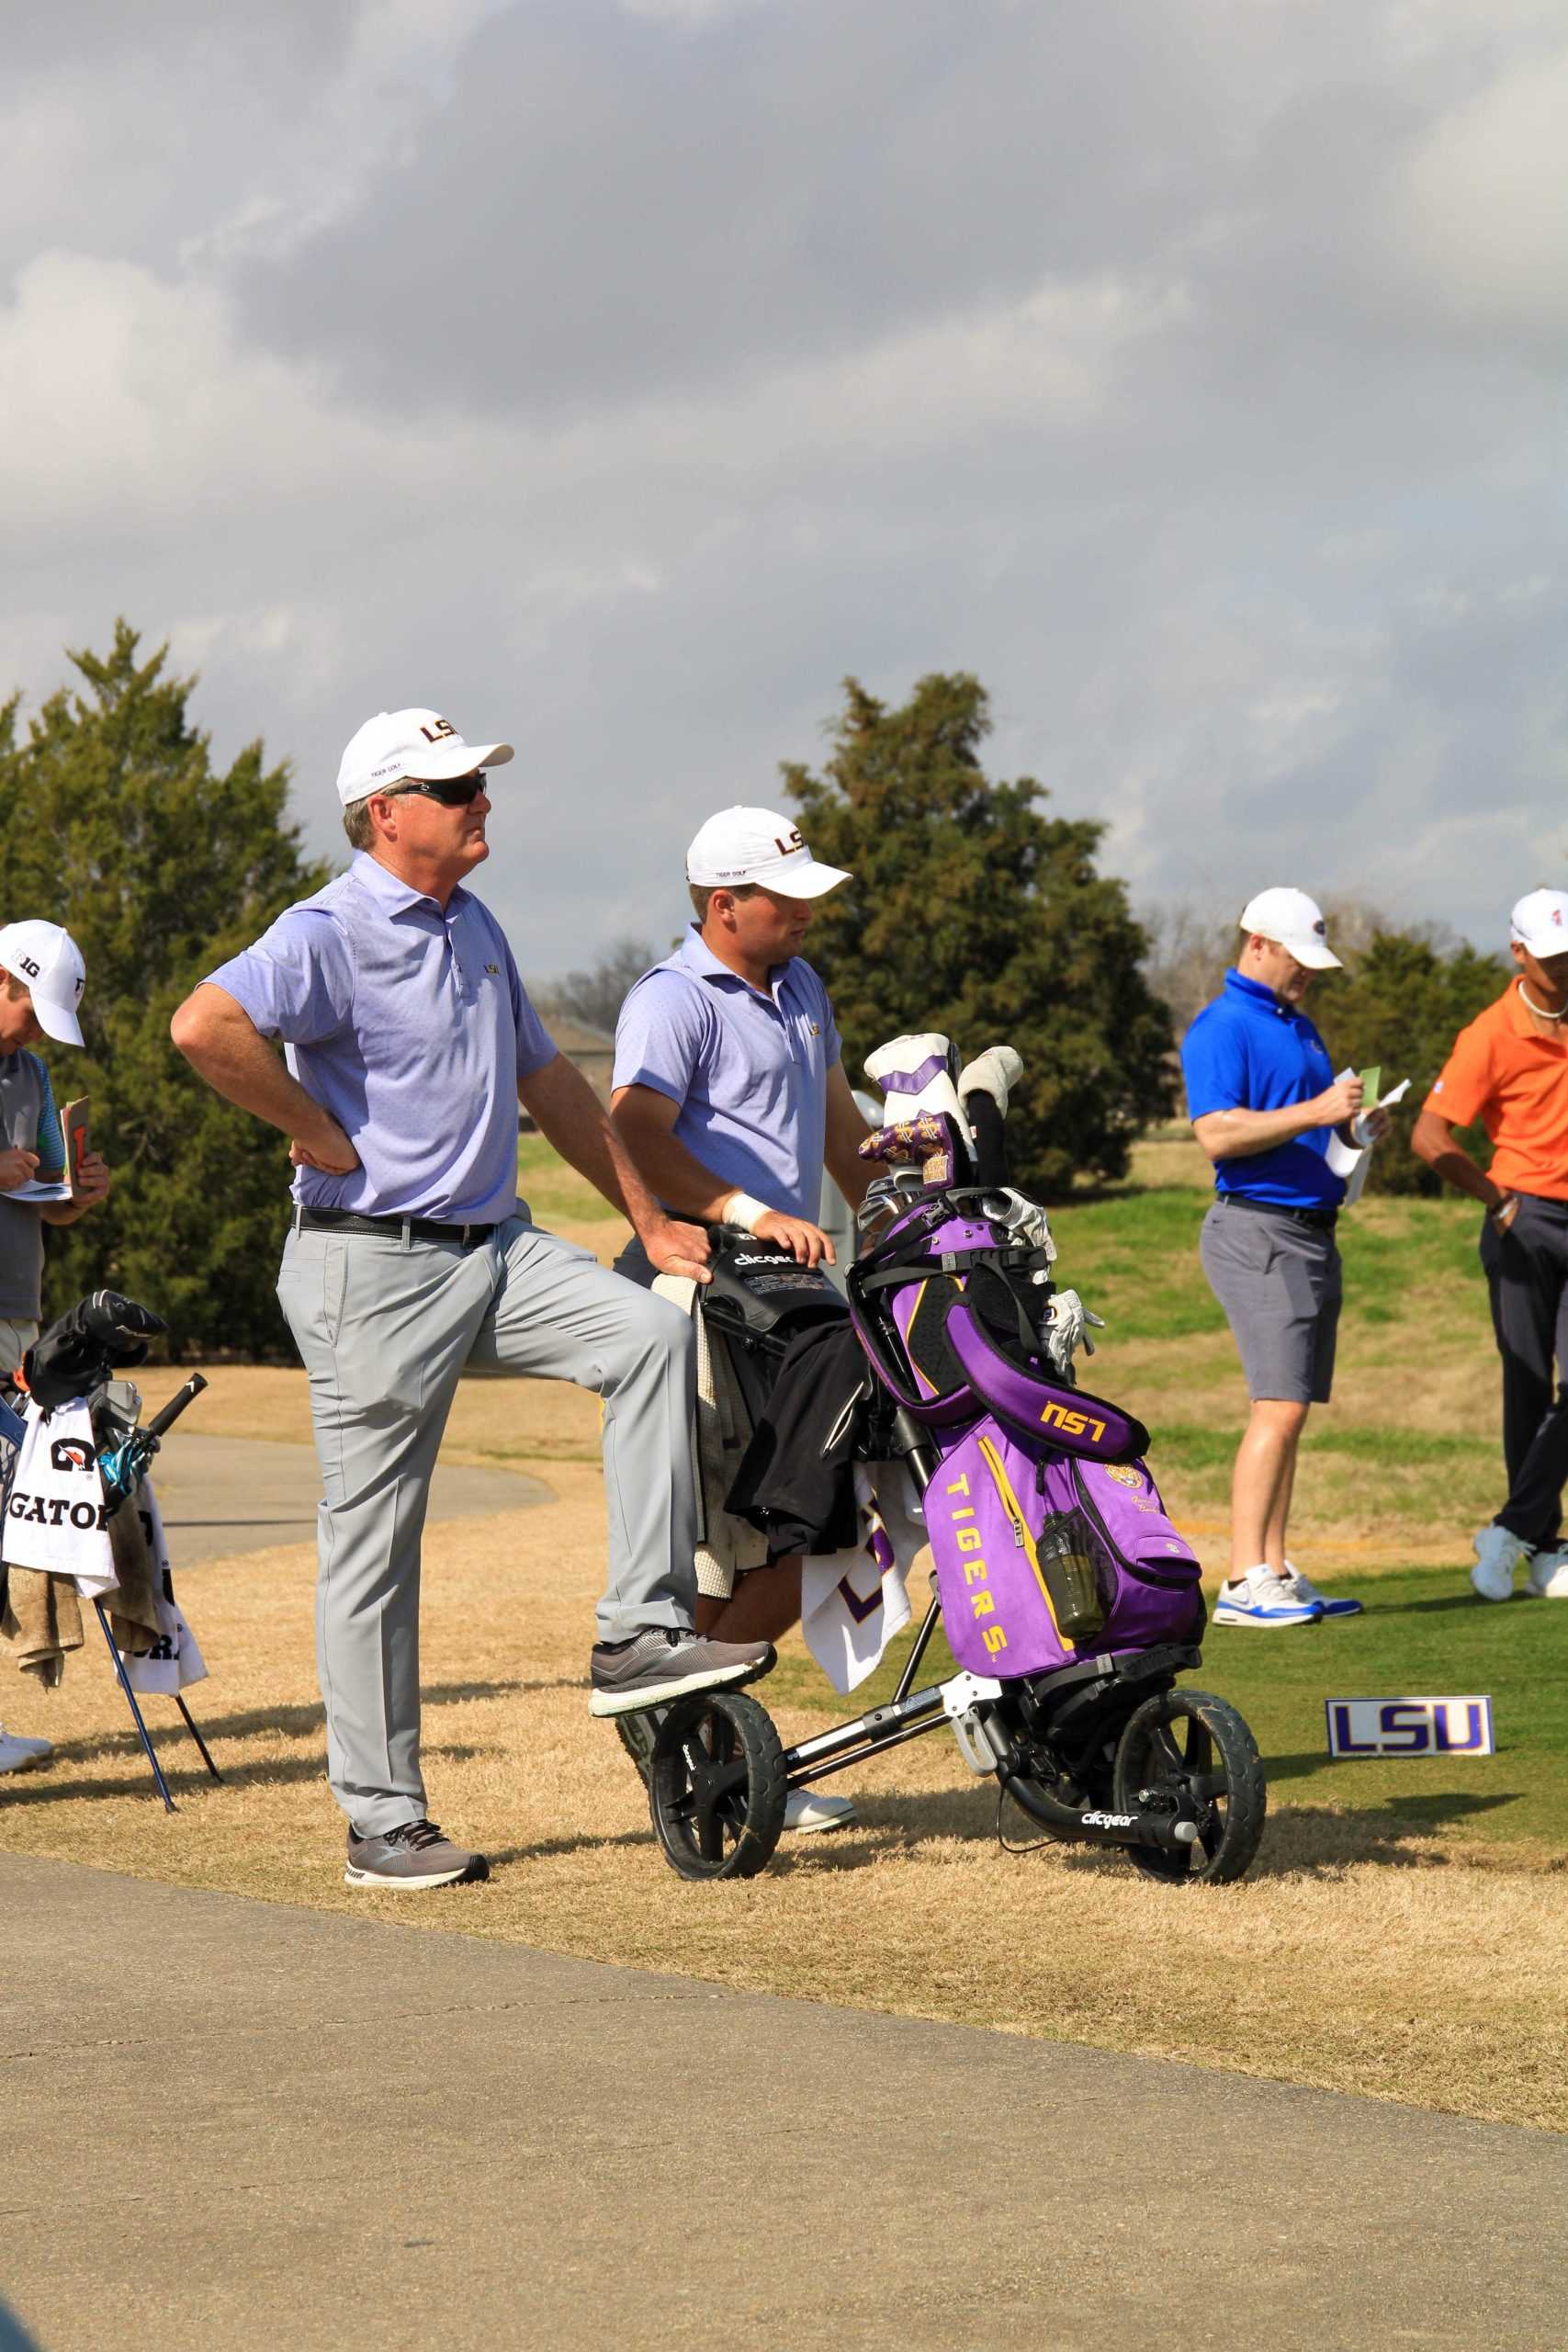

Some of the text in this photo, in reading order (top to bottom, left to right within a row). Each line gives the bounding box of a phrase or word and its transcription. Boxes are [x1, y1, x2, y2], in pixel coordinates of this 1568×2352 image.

[420, 719, 457, 743] LS
[774, 830, 804, 856] LS
[1040, 1402, 1107, 1443] LSU
[946, 1473, 1009, 1654] TIGERS
[1334, 1704, 1483, 1753] LSU
[1081, 1810, 1138, 1830] clicgear
